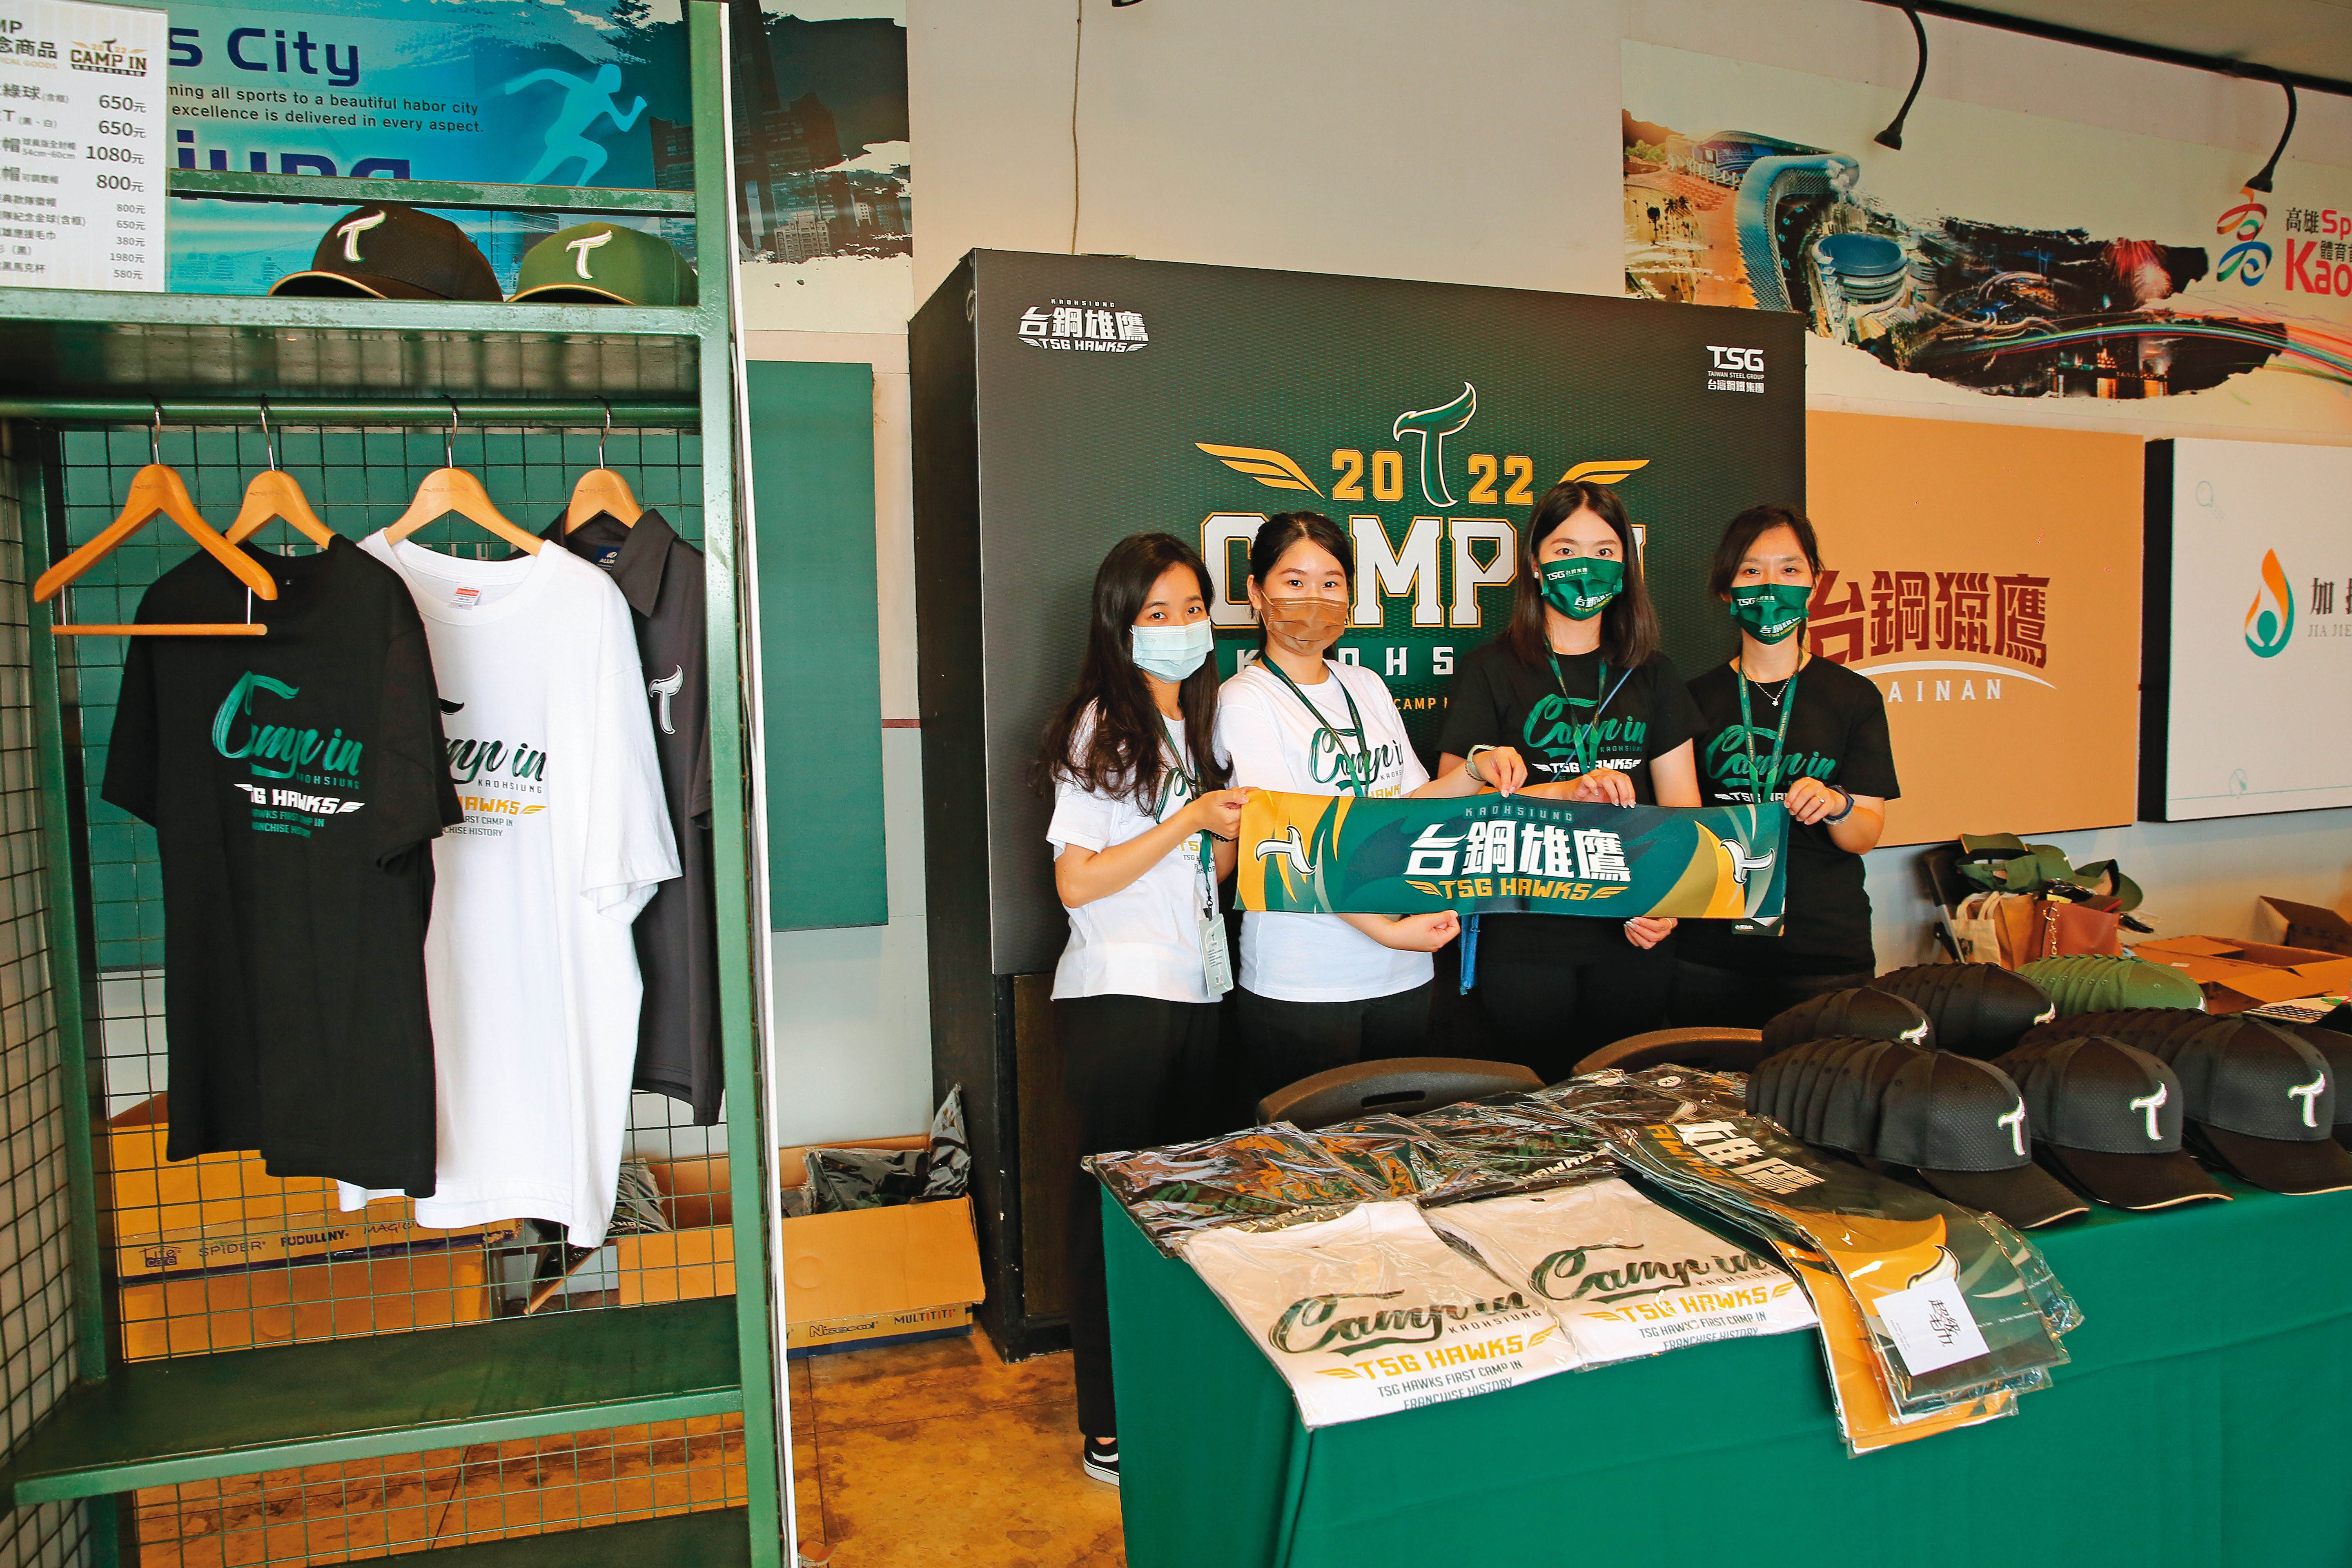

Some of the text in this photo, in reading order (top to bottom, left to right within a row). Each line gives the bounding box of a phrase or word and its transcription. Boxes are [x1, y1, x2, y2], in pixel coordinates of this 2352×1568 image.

[70, 49, 147, 70] CAMP IN
[227, 27, 360, 87] City
[99, 95, 146, 113] 650元
[212, 87, 229, 99] all
[236, 90, 287, 104] sports
[294, 91, 308, 105] to
[315, 96, 323, 105] a
[330, 94, 397, 110] beautiful
[403, 98, 445, 112] habor
[452, 100, 479, 116] city
[99, 120, 146, 138] 650元
[172, 105, 484, 133] excellence is delivered in every aspect.
[86, 146, 145, 164] 1080元
[97, 174, 145, 192] 800元
[117, 204, 146, 214] 800元
[2285, 207, 2320, 234] 高雄
[116, 220, 146, 230] 650元
[116, 236, 145, 247] 380元
[110, 252, 145, 263] 1980元
[114, 270, 143, 280] 580元
[1051, 298, 1115, 308] KAOHSIUNG
[1017, 305, 1149, 342] 台鋼雄鷹
[1038, 338, 1128, 353] TSG HAWKS
[1706, 345, 1764, 372] TSG
[1331, 448, 1403, 502] 20
[1468, 453, 1534, 506] 22
[1200, 512, 1518, 630] CMP
[1546, 570, 1565, 581] TSG
[1737, 597, 1756, 606] TSG
[1806, 570, 2051, 669] 台鋼獵鷹
[2308, 624, 2327, 637] JIA
[1886, 679, 2001, 703] AINAN
[1623, 716, 1646, 744] in
[512, 743, 546, 782] in
[1549, 762, 1580, 773] TSG
[1806, 751, 1836, 780] in
[478, 779, 542, 793] KAOHSIUNG
[272, 789, 341, 814] HAWKS
[465, 815, 480, 824] RST
[482, 817, 504, 826] CAMP
[1466, 806, 1573, 822] KAOHSIUNG
[443, 826, 503, 837] CHISE HISTORY
[1403, 820, 1631, 882] 台鋼雄鷹
[1439, 878, 1592, 901] TSG HAWKS
[1528, 1243, 1767, 1303] Camp in
[1696, 1269, 1780, 1287] KAOHSIUNG
[1615, 1287, 1768, 1323] TSG HAWKS
[1269, 1289, 1530, 1357] Camp in
[1448, 1310, 1542, 1334] KAOHSIUNG
[1638, 1327, 1660, 1339] TSG
[1701, 1316, 1725, 1327] FIRST
[1727, 1313, 1753, 1325] CAMP
[1756, 1311, 1767, 1321] IN
[1354, 1335, 1523, 1380] TSG HAWKS
[1377, 1360, 1523, 1398] TSG HAWKS FIRST CAMP IN
